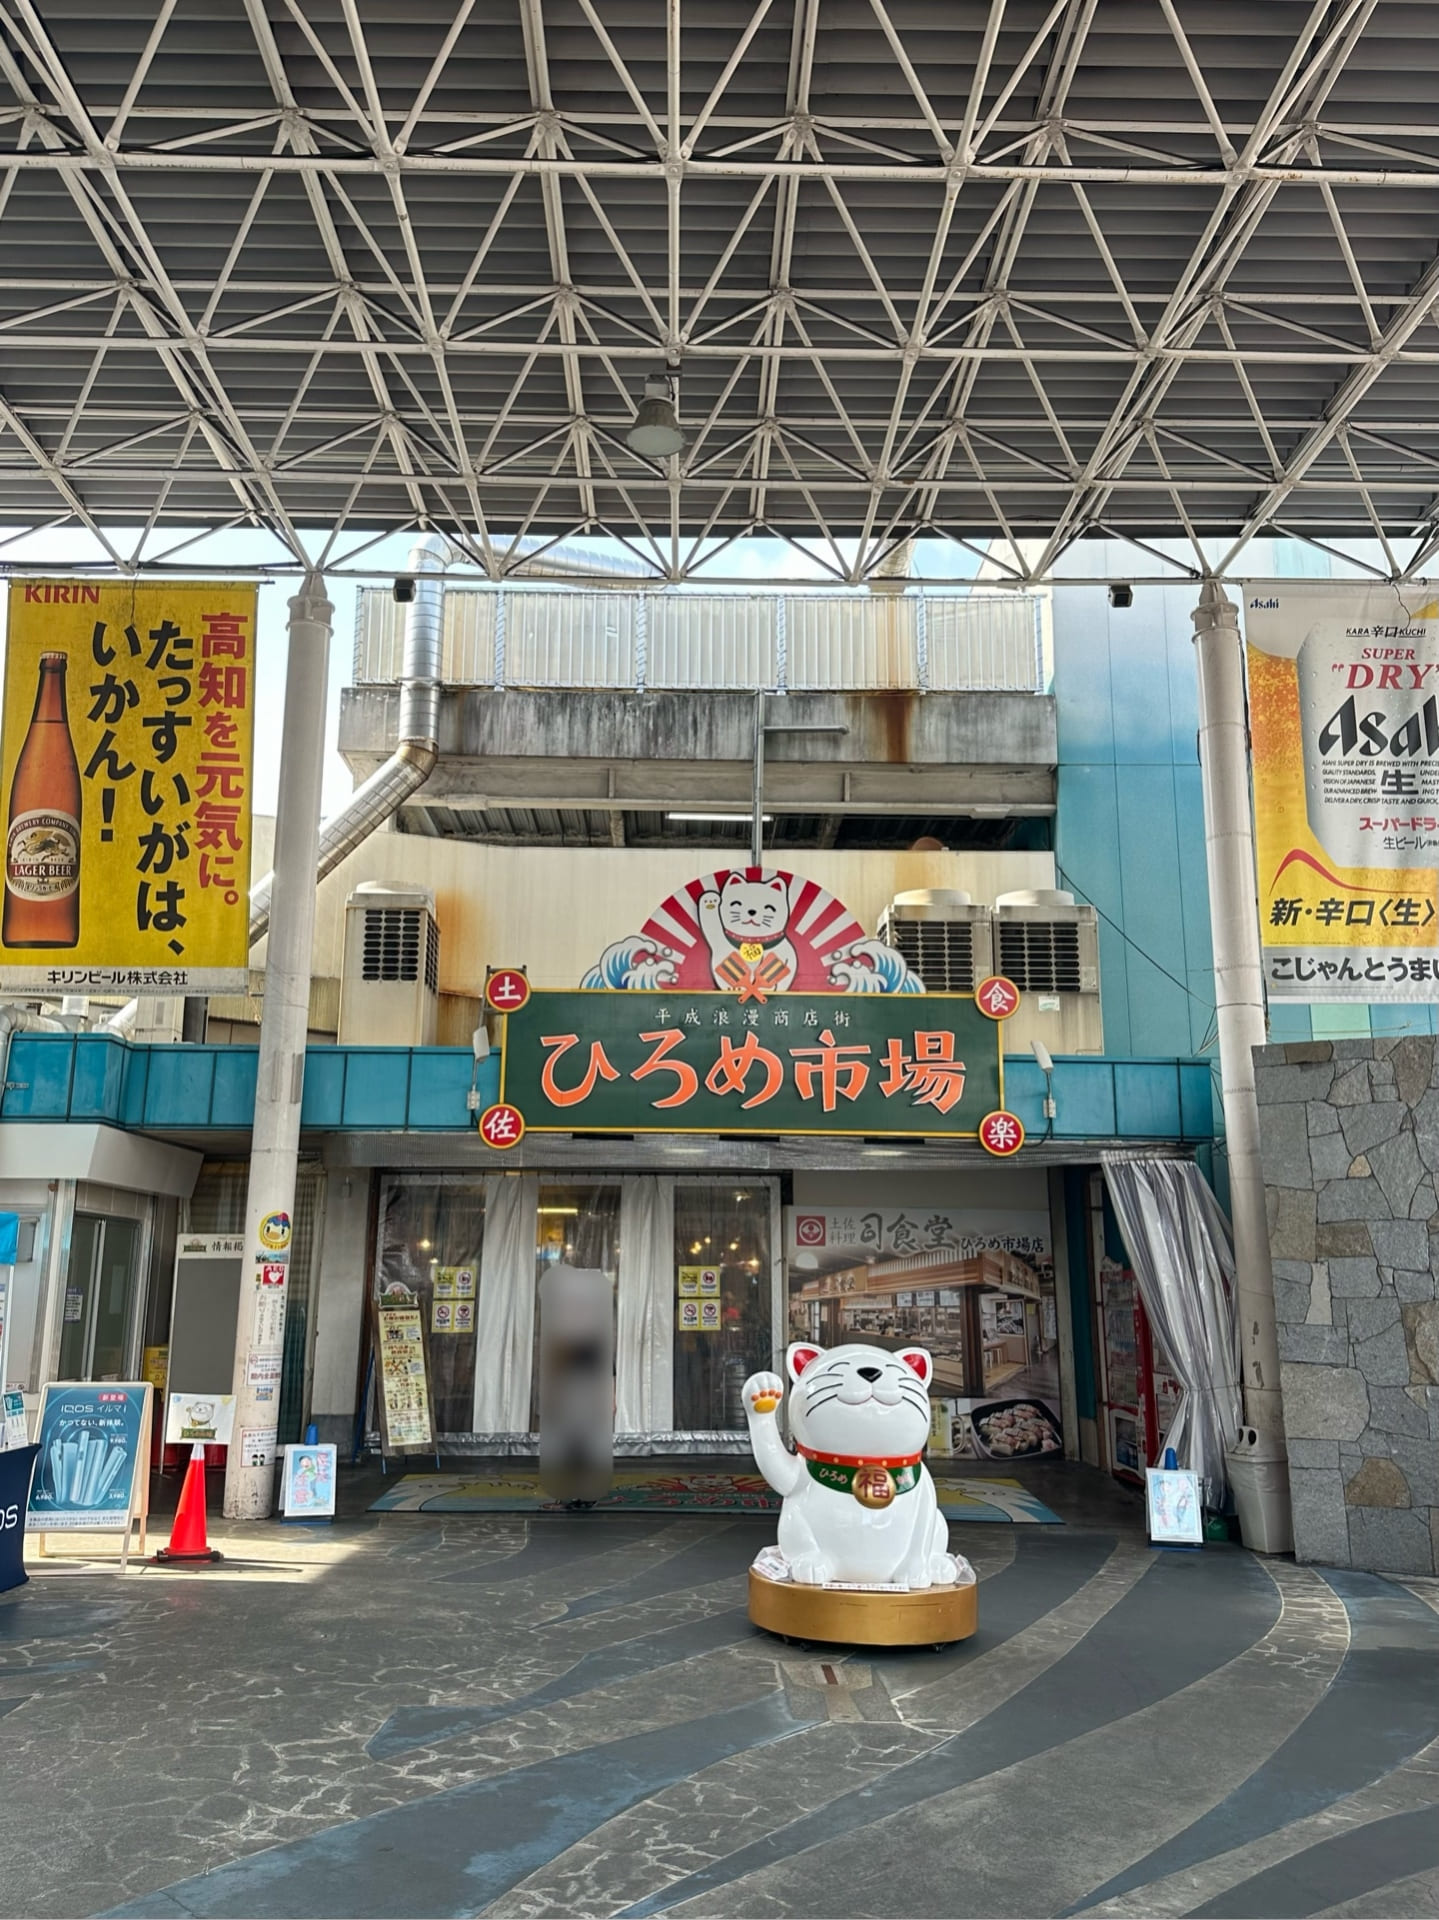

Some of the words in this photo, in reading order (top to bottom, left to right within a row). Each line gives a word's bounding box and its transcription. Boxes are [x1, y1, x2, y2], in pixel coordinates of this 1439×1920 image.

[24, 584, 101, 604] KIRIN
[1249, 597, 1279, 609] Asahi
[1346, 627, 1369, 636] KARA
[1371, 625, 1398, 638] 辛口
[1398, 628, 1427, 637] KUCHI
[1361, 648, 1416, 661] SUPER
[194, 612, 249, 906] 高知を元気に。
[136, 620, 195, 956] たっすいがは、
[1380, 769, 1419, 795] 生
[1359, 816, 1439, 832] スーパードラ
[1383, 836, 1427, 850] 生ビール
[14, 865, 46, 876] LAGER
[49, 865, 72, 876] BEER
[47, 970, 188, 985] キリンビール株式会社
[493, 975, 522, 1002] 土
[982, 981, 1015, 1013] 食
[655, 1008, 850, 1026] 平成浪漫商店街
[539, 1027, 967, 1115] ひろめ市場
[484, 1109, 517, 1140] 佐
[987, 1117, 1017, 1149] 楽
[859, 1213, 956, 1251] 司食堂
[960, 1236, 1044, 1253] ひろめ市場店
[61, 1404, 94, 1414] IQOS
[819, 1468, 848, 1484] ひろめ
[858, 1469, 890, 1500] 福
